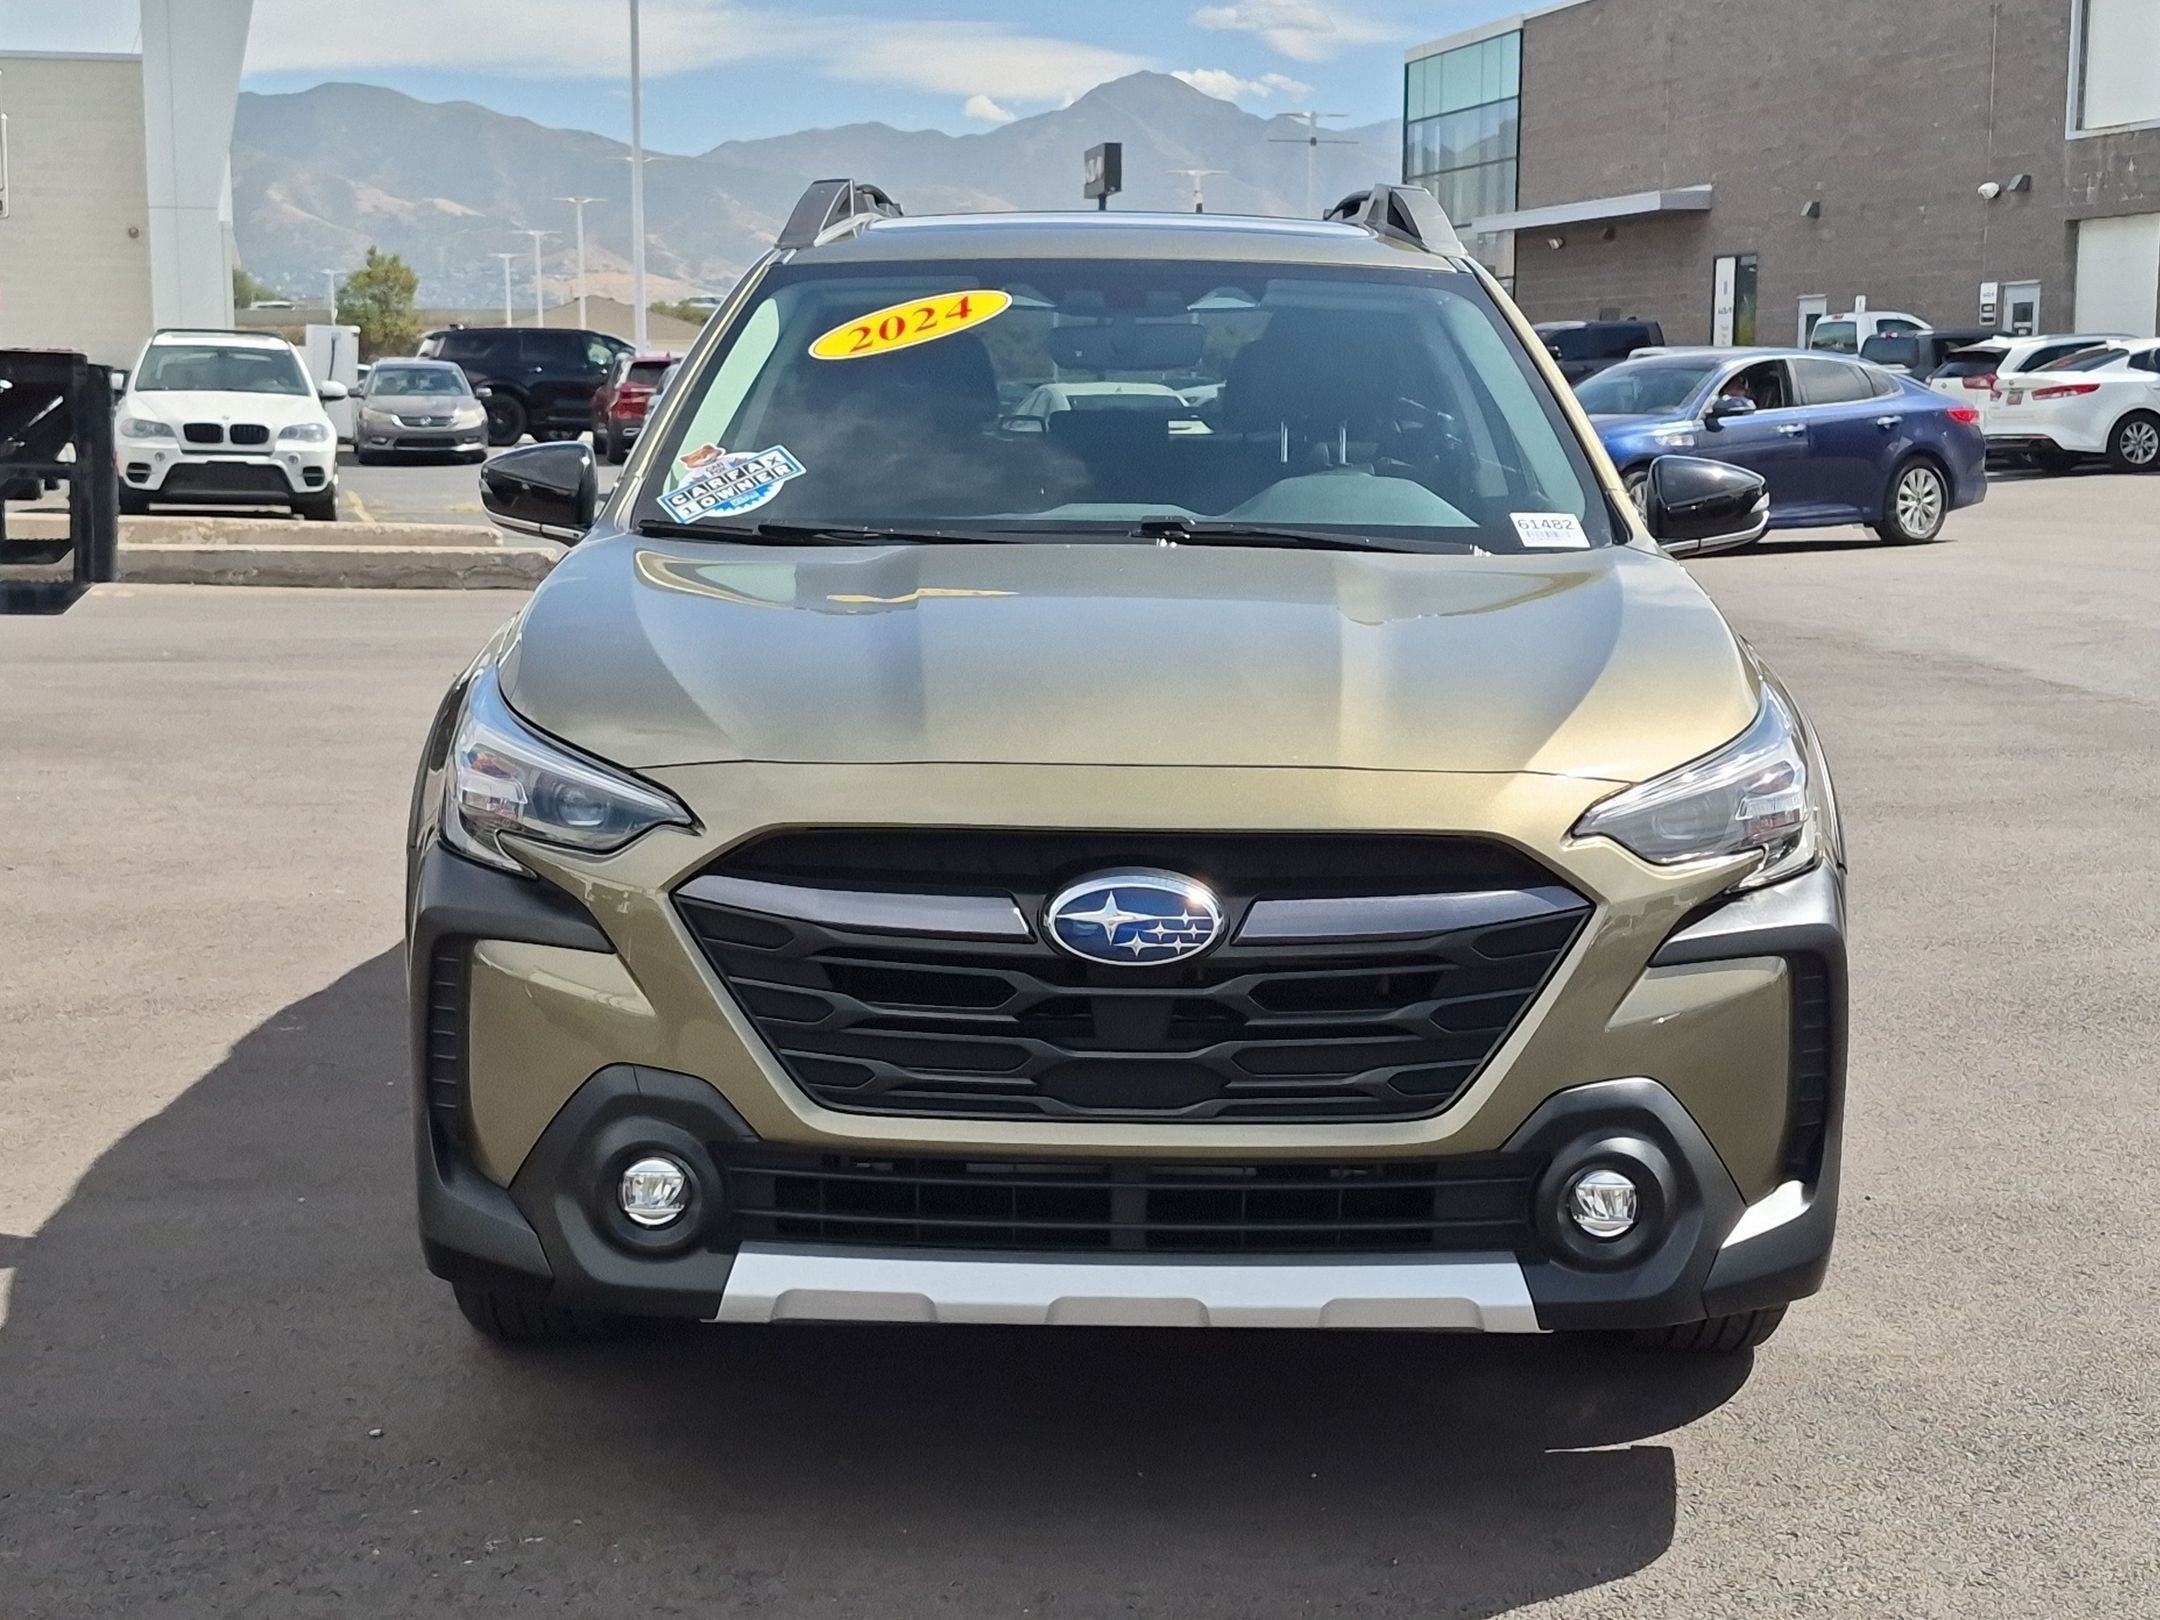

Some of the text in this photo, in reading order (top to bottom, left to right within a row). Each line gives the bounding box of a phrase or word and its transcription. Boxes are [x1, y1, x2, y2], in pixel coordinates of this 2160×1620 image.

[848, 295, 972, 353] 2024
[671, 455, 783, 506] CARFAX
[699, 464, 793, 508] OWNER
[1517, 519, 1576, 530] 61482
